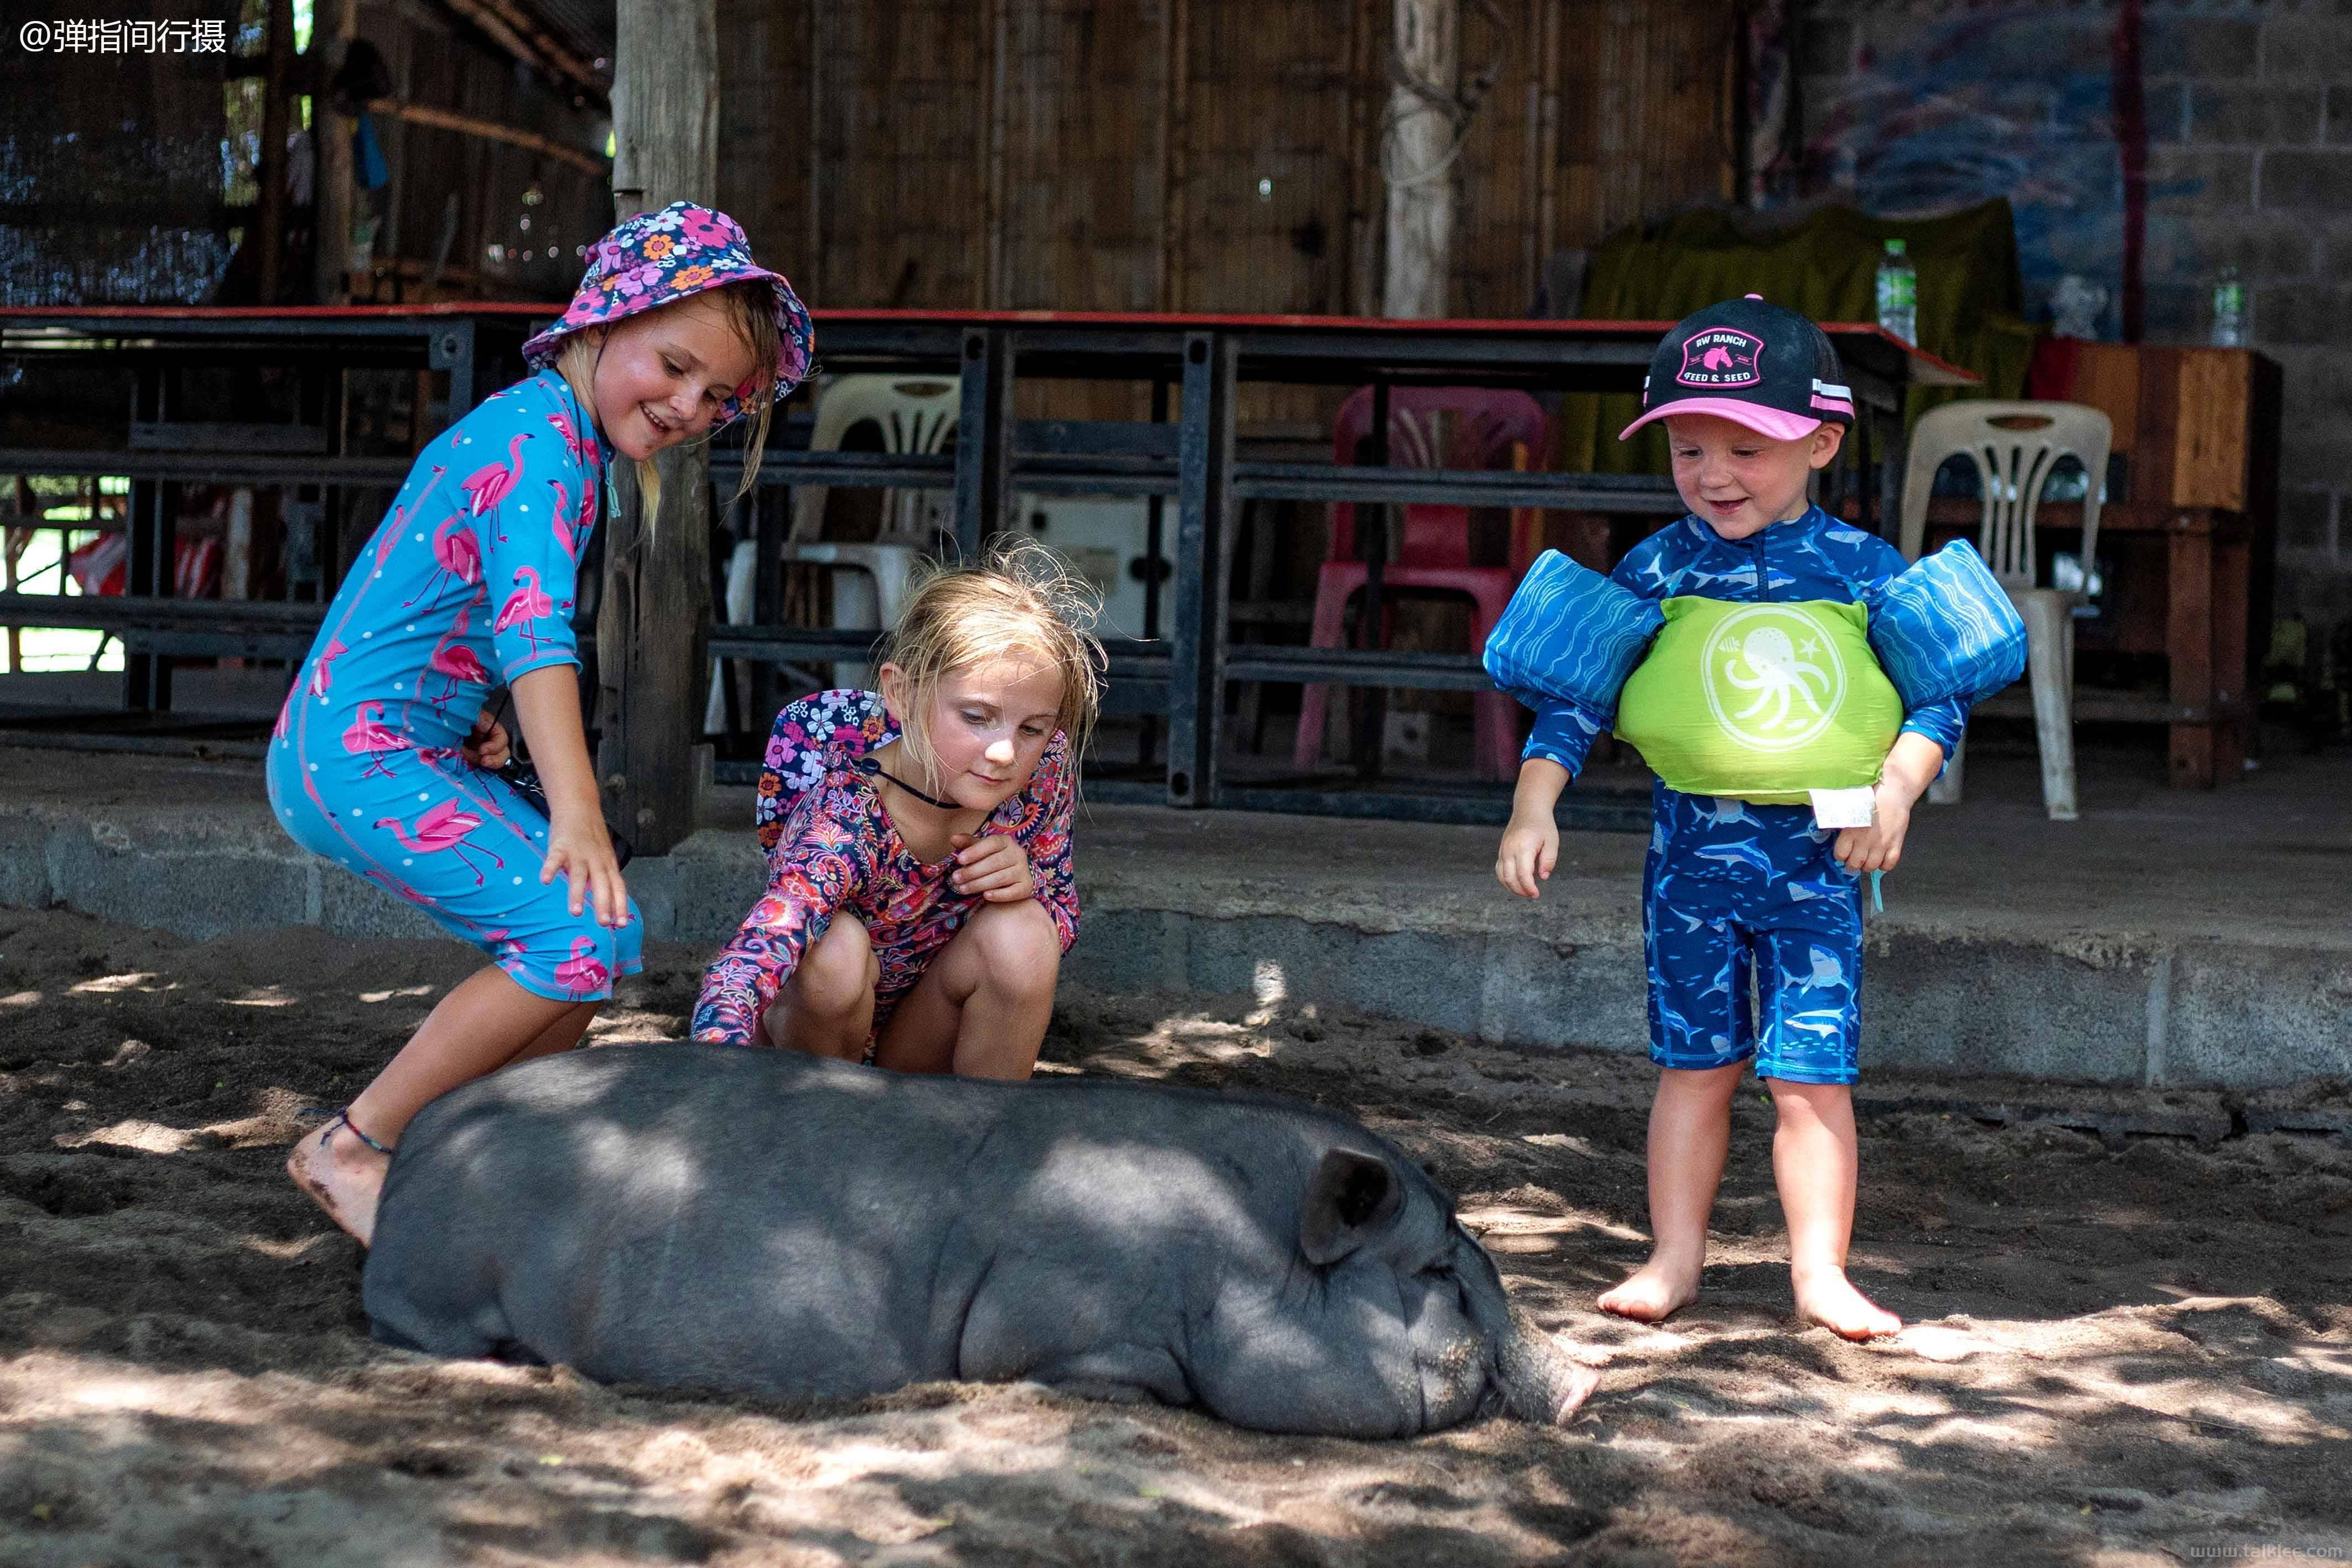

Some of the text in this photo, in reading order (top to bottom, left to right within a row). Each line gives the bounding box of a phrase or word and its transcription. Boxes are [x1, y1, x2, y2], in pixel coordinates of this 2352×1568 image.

[1696, 334, 1747, 347] RW RANCH
[1684, 372, 1709, 382] FEED
[1724, 372, 1751, 382] SEED
